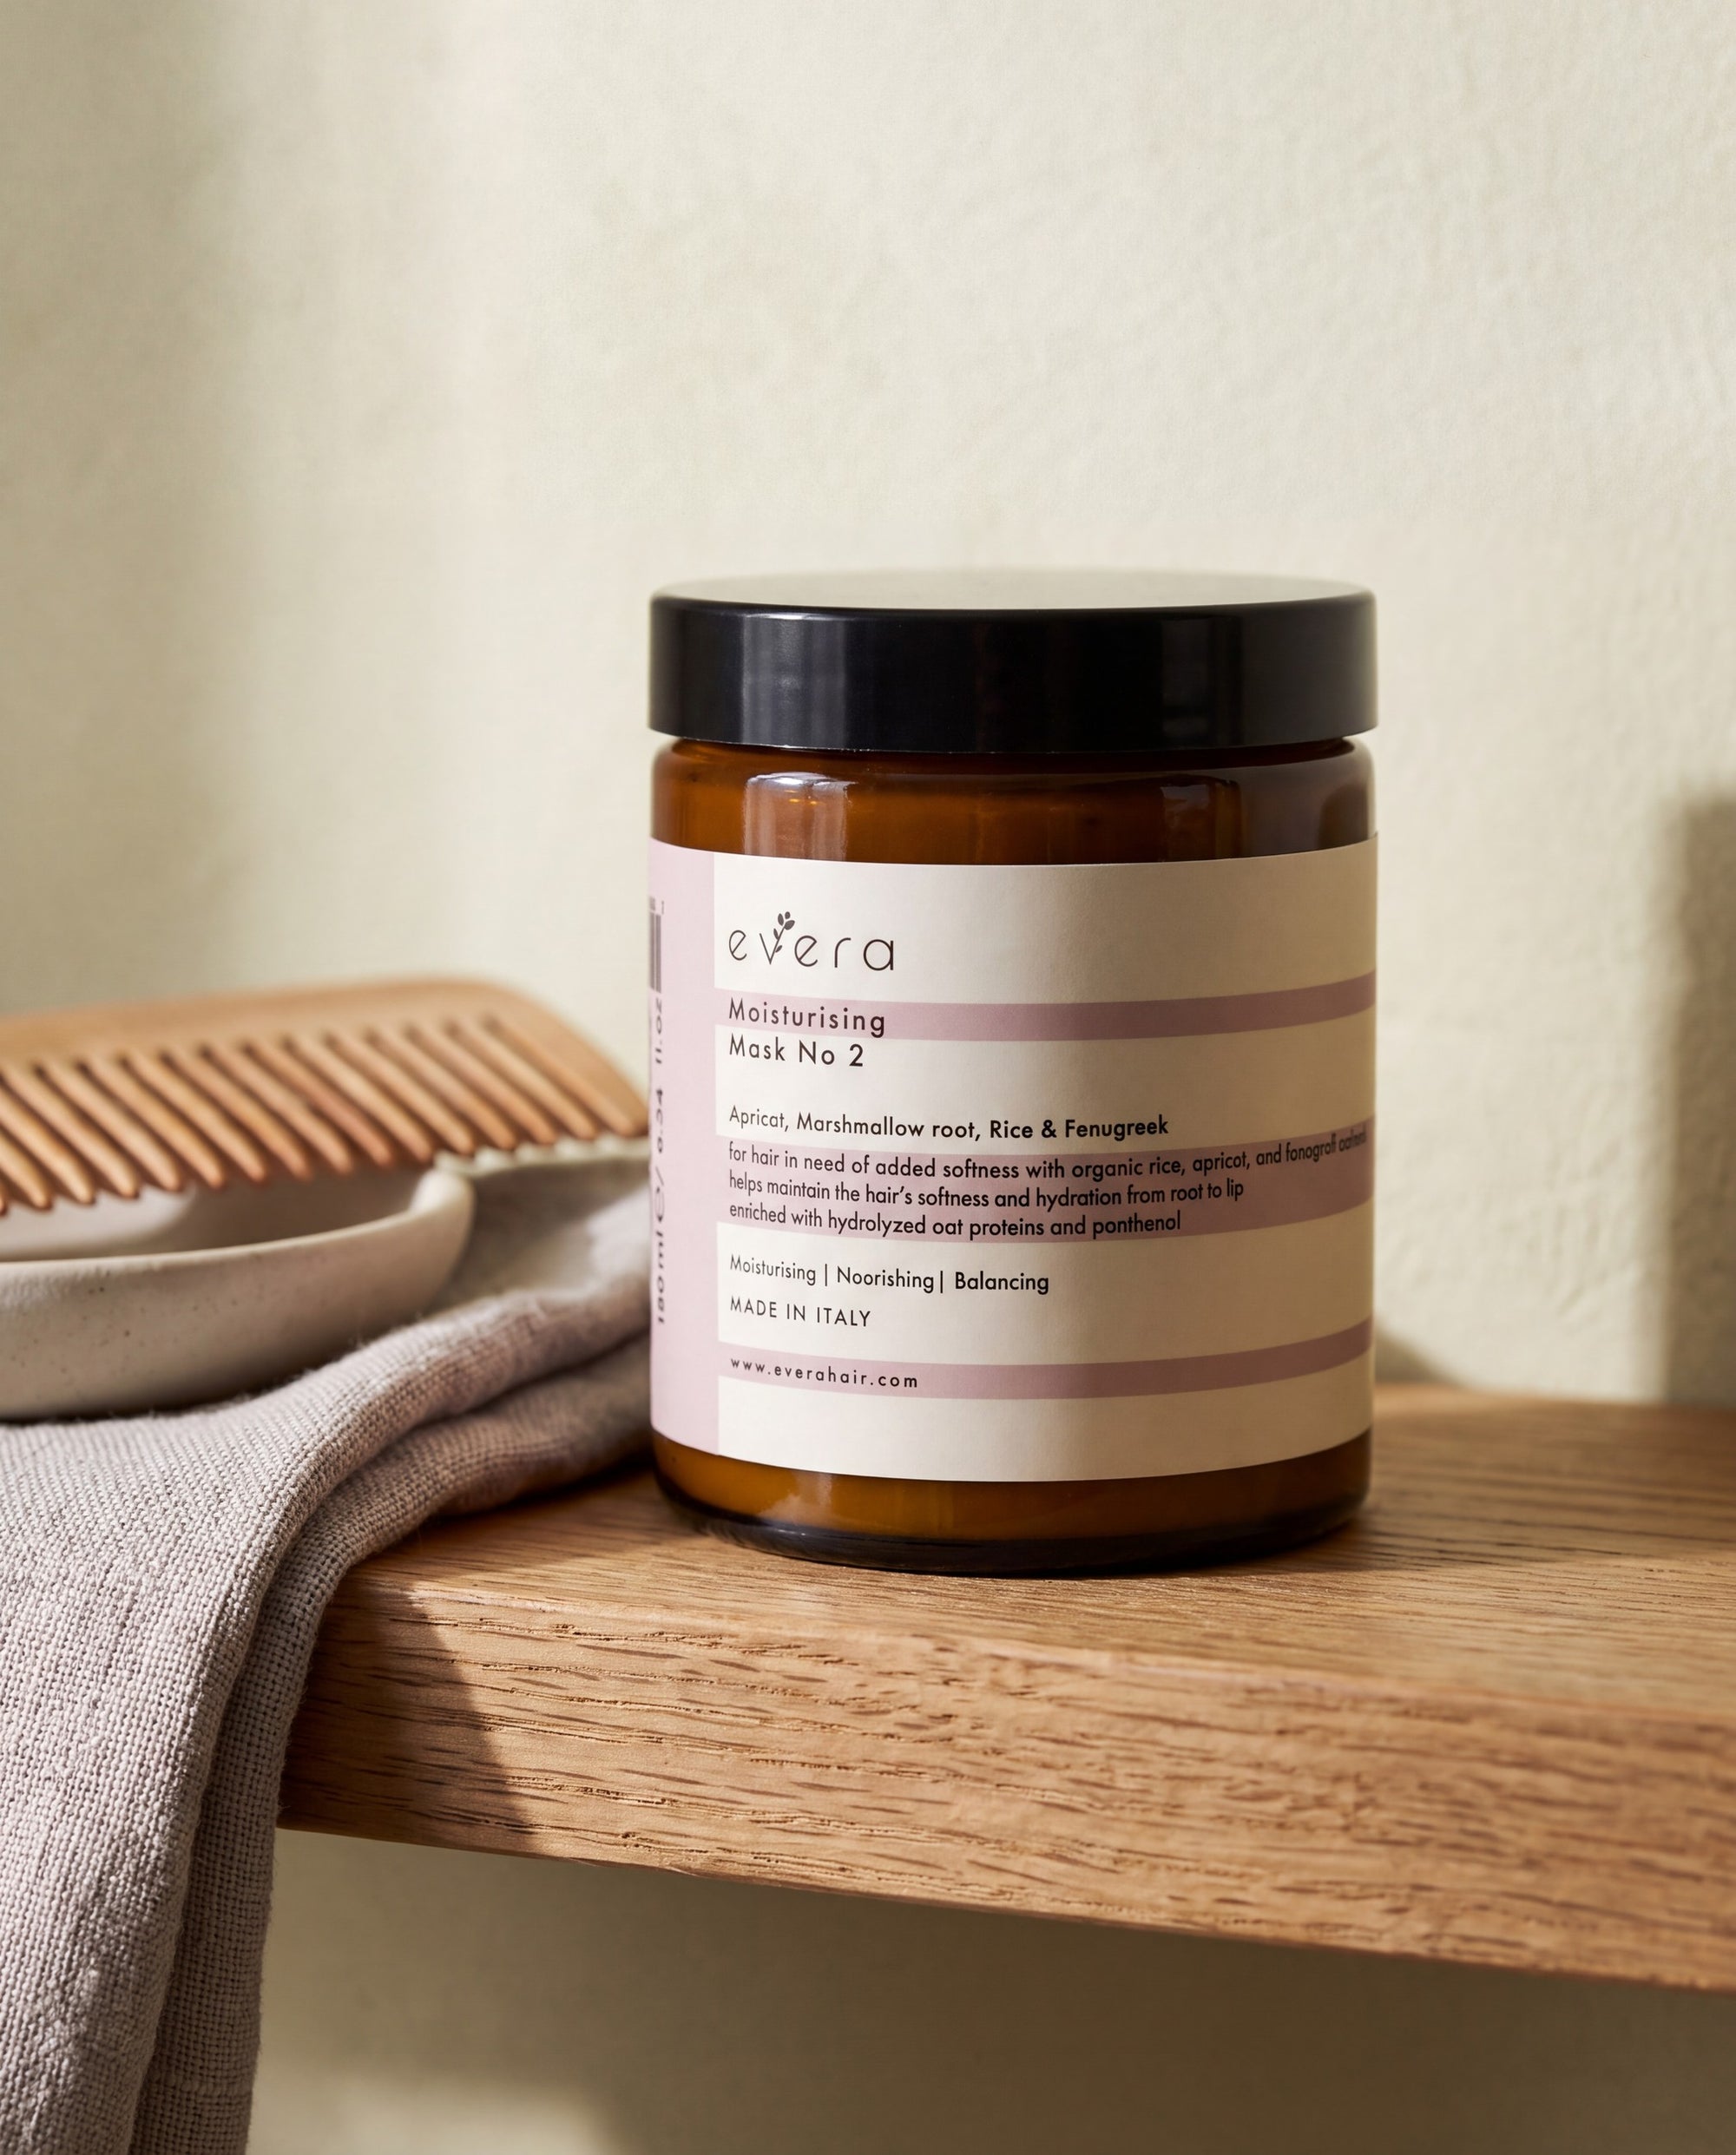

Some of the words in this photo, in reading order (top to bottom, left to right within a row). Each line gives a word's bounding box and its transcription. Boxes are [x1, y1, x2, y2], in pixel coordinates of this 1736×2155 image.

[729, 911, 894, 970] evera
[729, 997, 885, 1038] Moisturising
[729, 1033, 786, 1061] Mask
[799, 1041, 835, 1066] No
[849, 1043, 864, 1067] 2
[797, 1112, 924, 1137] Marshmallow
[932, 1120, 982, 1141] root,
[990, 1120, 1034, 1139] Rice
[1041, 1120, 1057, 1139] &
[1065, 1114, 1169, 1141] Fenugreek
[729, 1141, 746, 1161] for
[752, 1145, 779, 1166] hair
[785, 1152, 798, 1168] in
[805, 1153, 845, 1173] need
[852, 1154, 870, 1174] of
[876, 1157, 936, 1177] added
[943, 1158, 1019, 1179] softness
[1026, 1159, 1064, 1179] with
[1072, 1158, 1143, 1182] organic
[1149, 1155, 1186, 1177] rice,
[1193, 1150, 1251, 1175] apricot,
[1256, 1143, 1281, 1165] and
[729, 1170, 763, 1193] helps
[767, 1178, 831, 1200] maintain
[835, 1184, 860, 1202] the
[918, 1186, 989, 1207] softness
[995, 1186, 1029, 1207] and
[1036, 1186, 1121, 1212] hydration
[1127, 1182, 1165, 1205] from
[1171, 1181, 1203, 1201] root
[1207, 1181, 1222, 1199] to
[1226, 1179, 1244, 1201] lip
[729, 1202, 786, 1224] enriched
[791, 1209, 822, 1227] with
[828, 1209, 926, 1237] hydrolyzed
[932, 1219, 963, 1236] oat
[970, 1218, 1044, 1240] proteins
[1050, 1215, 1086, 1236] and
[730, 1254, 816, 1286] Moisturising
[837, 1265, 934, 1293] Noorishing
[955, 1271, 1049, 1295] Balancing
[730, 1296, 778, 1318] MADE
[786, 1304, 806, 1322] IN
[817, 1307, 871, 1327] ITALY
[730, 1358, 917, 1389] www.everahair.com
